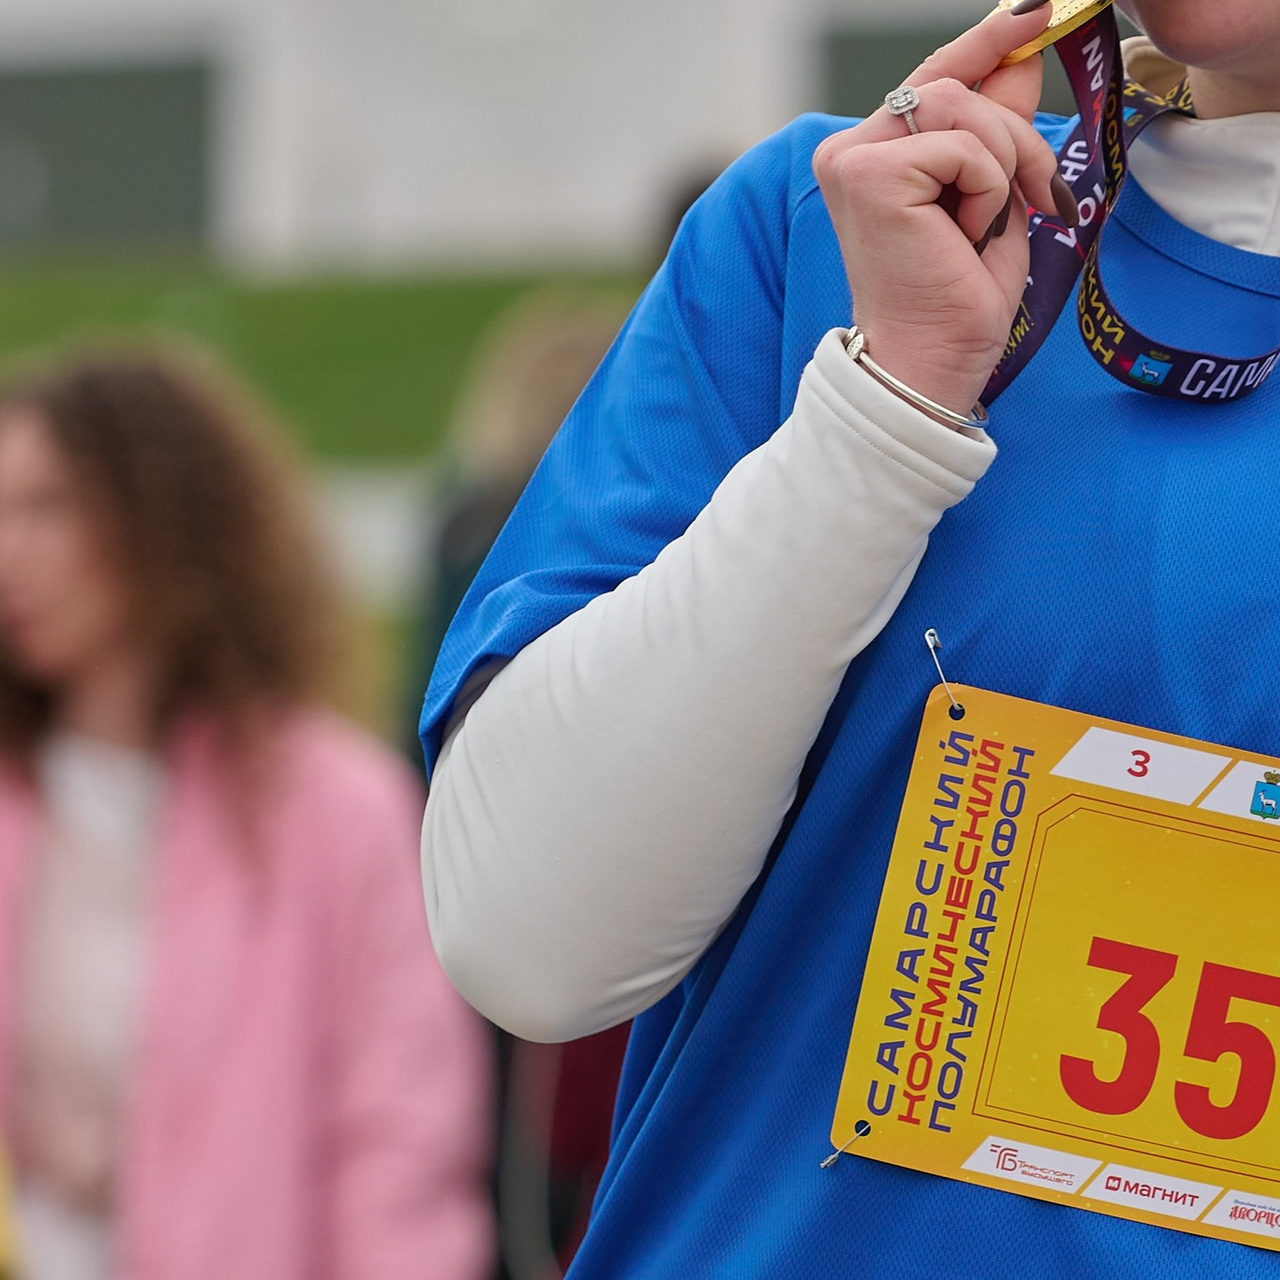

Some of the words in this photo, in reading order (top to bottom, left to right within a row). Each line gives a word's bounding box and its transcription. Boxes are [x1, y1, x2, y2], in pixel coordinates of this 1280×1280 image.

[867, 729, 975, 1117] САМАРСКИЙ
[897, 738, 1005, 1126] КОСМИЧЕСКИЙ
[928, 745, 1036, 1133] ПОЛУМАРАФОН
[1126, 749, 1152, 779] 3
[1122, 1179, 1200, 1208] магнит
